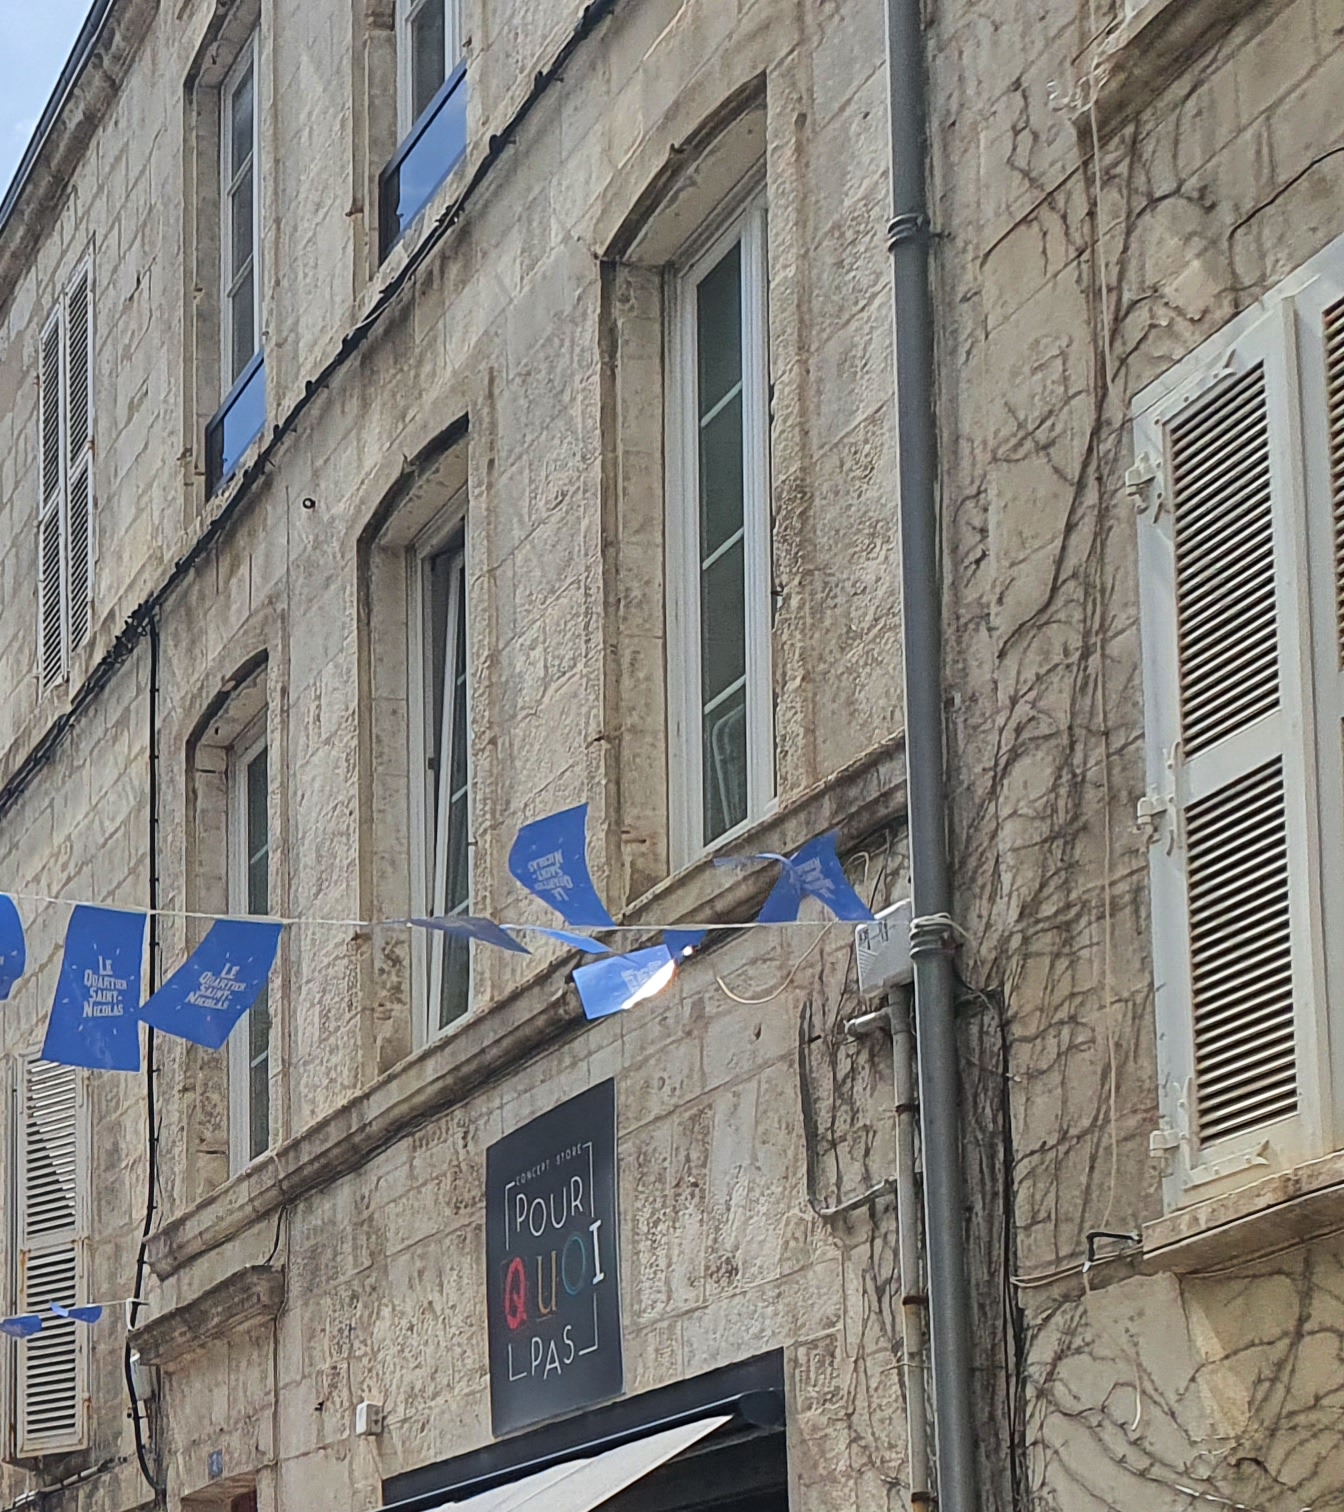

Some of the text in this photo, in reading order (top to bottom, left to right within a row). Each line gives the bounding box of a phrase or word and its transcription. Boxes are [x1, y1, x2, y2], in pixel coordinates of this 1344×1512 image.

[516, 1176, 583, 1237] POUR
[504, 1220, 605, 1329] QUOI
[530, 1325, 575, 1380] PAS
